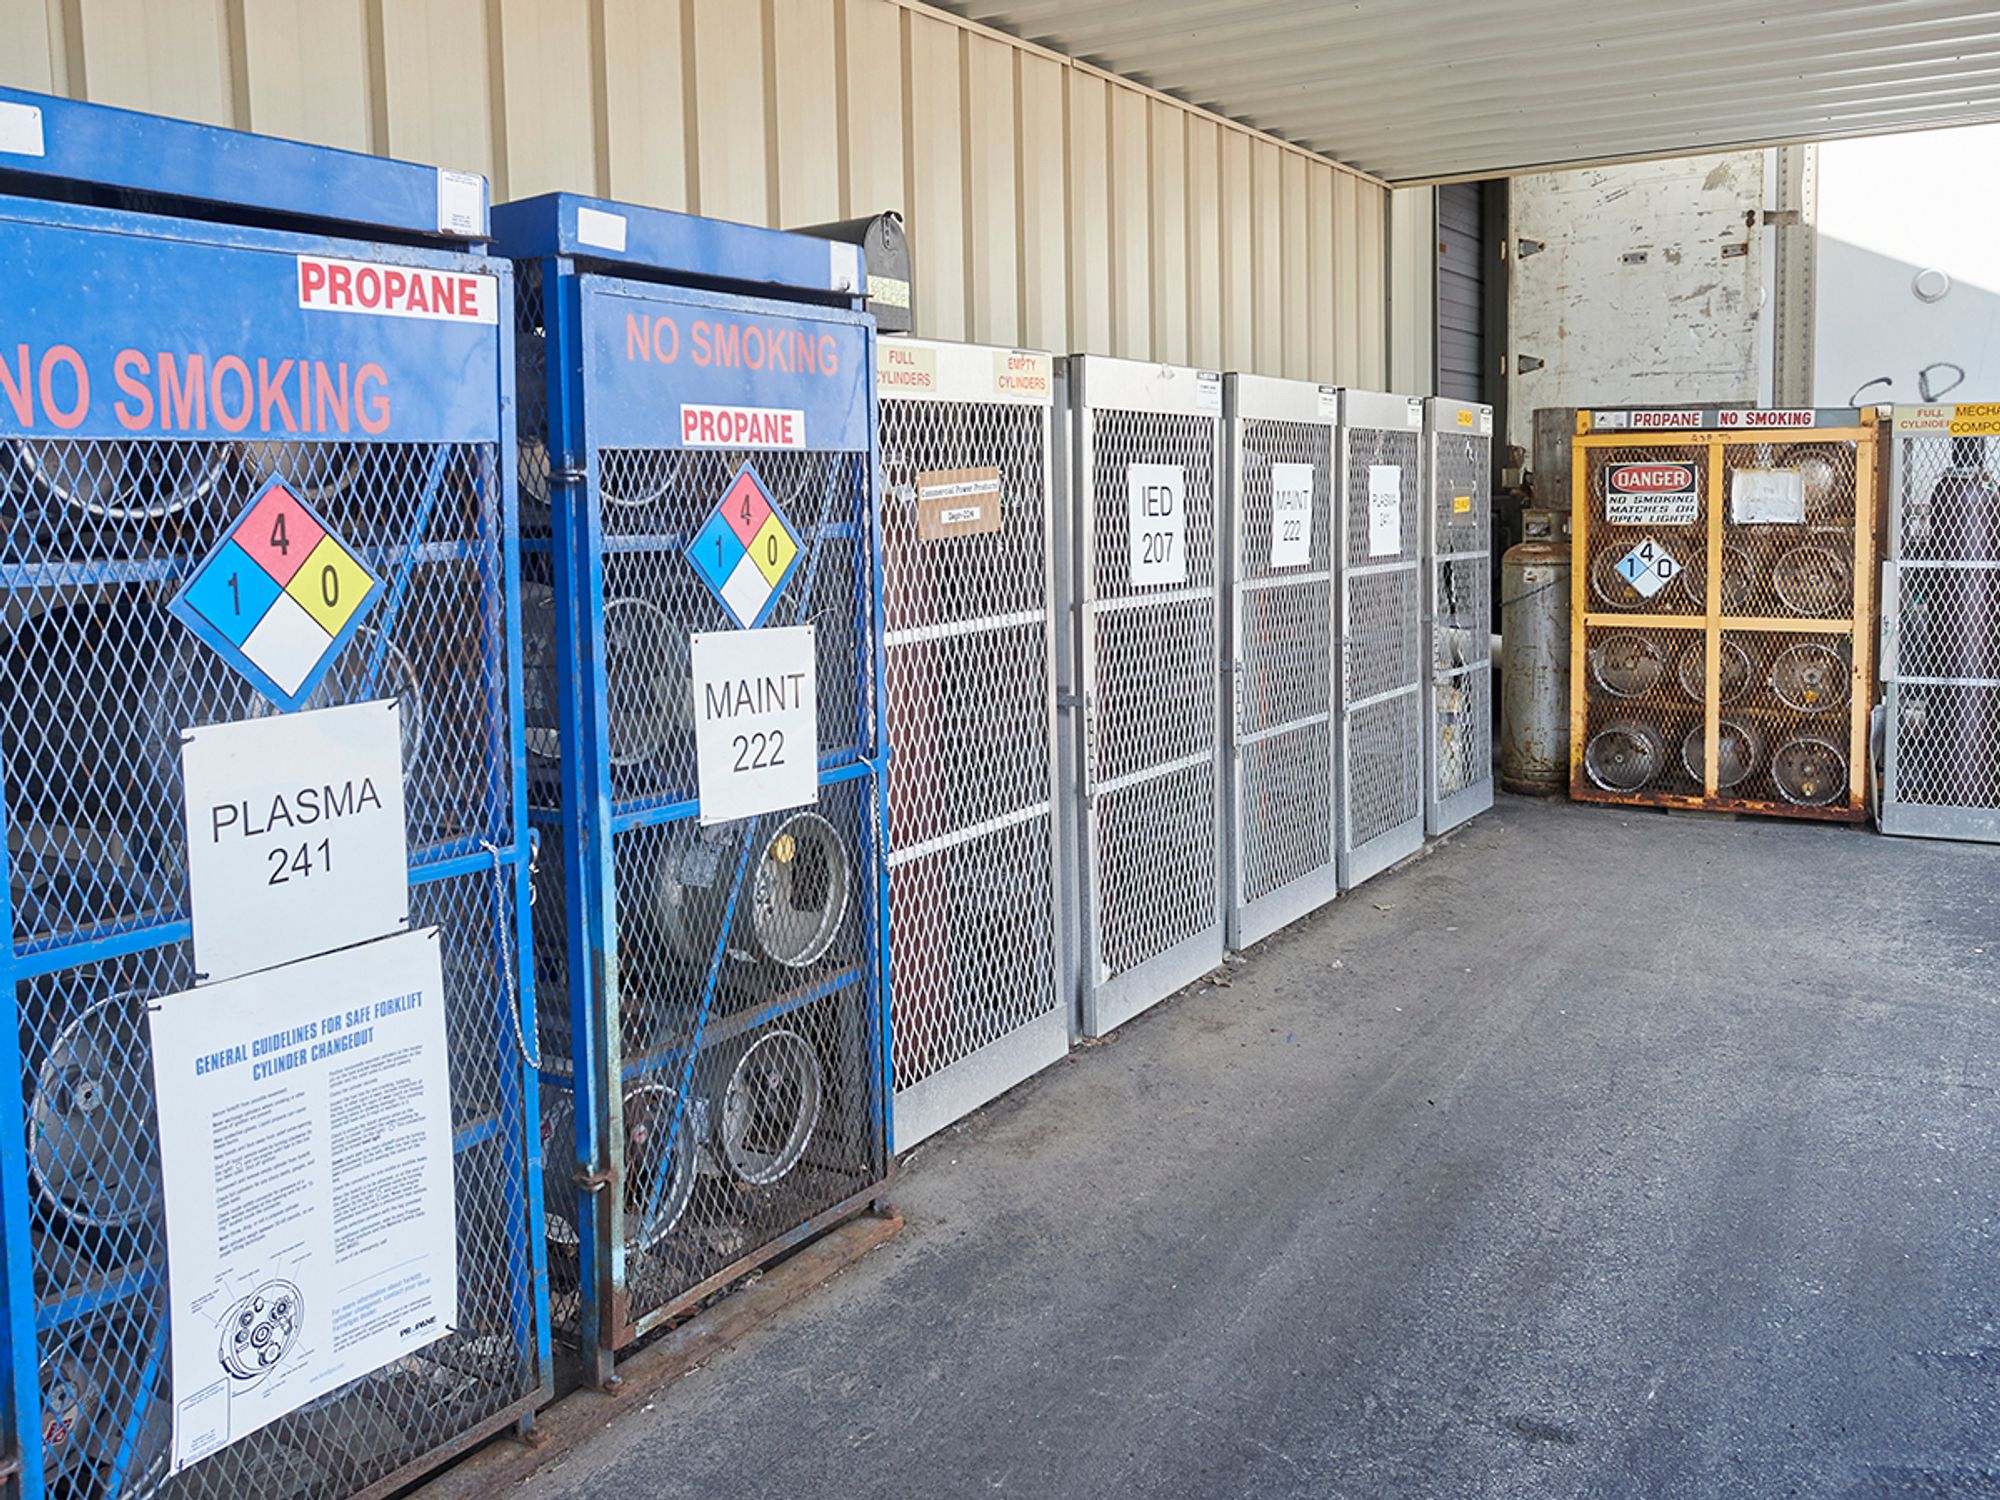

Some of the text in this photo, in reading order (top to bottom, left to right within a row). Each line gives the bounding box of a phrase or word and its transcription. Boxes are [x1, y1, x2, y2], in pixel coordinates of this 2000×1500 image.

[301, 262, 479, 317] PROPANE
[626, 313, 838, 376] NO SMOKING
[889, 350, 915, 365] FULL
[1008, 357, 1036, 372] EMPTY
[0, 343, 391, 435] NO SMOKING
[998, 375, 1046, 390] CYLINDERS
[683, 410, 793, 444] PROPANE
[1633, 412, 1699, 426] PROPANE
[1720, 411, 1811, 426] NO SMOKING
[1917, 408, 1944, 418] FULL
[1618, 471, 1685, 487] DANGER
[740, 494, 751, 526] 4
[1142, 486, 1173, 516] IED
[1276, 490, 1309, 511] MAINT
[1609, 495, 1694, 504] NO SMOKING
[1609, 504, 1695, 513] MATCHES OR
[1283, 520, 1301, 541] 222
[1609, 514, 1643, 523] OPEN
[270, 513, 289, 556] 4
[1142, 532, 1173, 564] 207
[715, 535, 723, 568] 1
[767, 534, 778, 567] 0
[1640, 543, 1654, 562] 4
[1626, 558, 1635, 577] 1
[1657, 558, 1672, 578] 0
[227, 572, 241, 616] 1
[321, 564, 339, 608] 0
[705, 673, 806, 720] MAINT
[732, 729, 786, 773] 222
[212, 776, 382, 843] PLASMA
[268, 837, 333, 886] 241
[195, 991, 423, 1076] GENERAL GUIDELINES FOR SAFE FORKLIFT
[252, 1026, 375, 1081] CYLINDER CHANGEOUT
[400, 1314, 437, 1337] PRPANE
